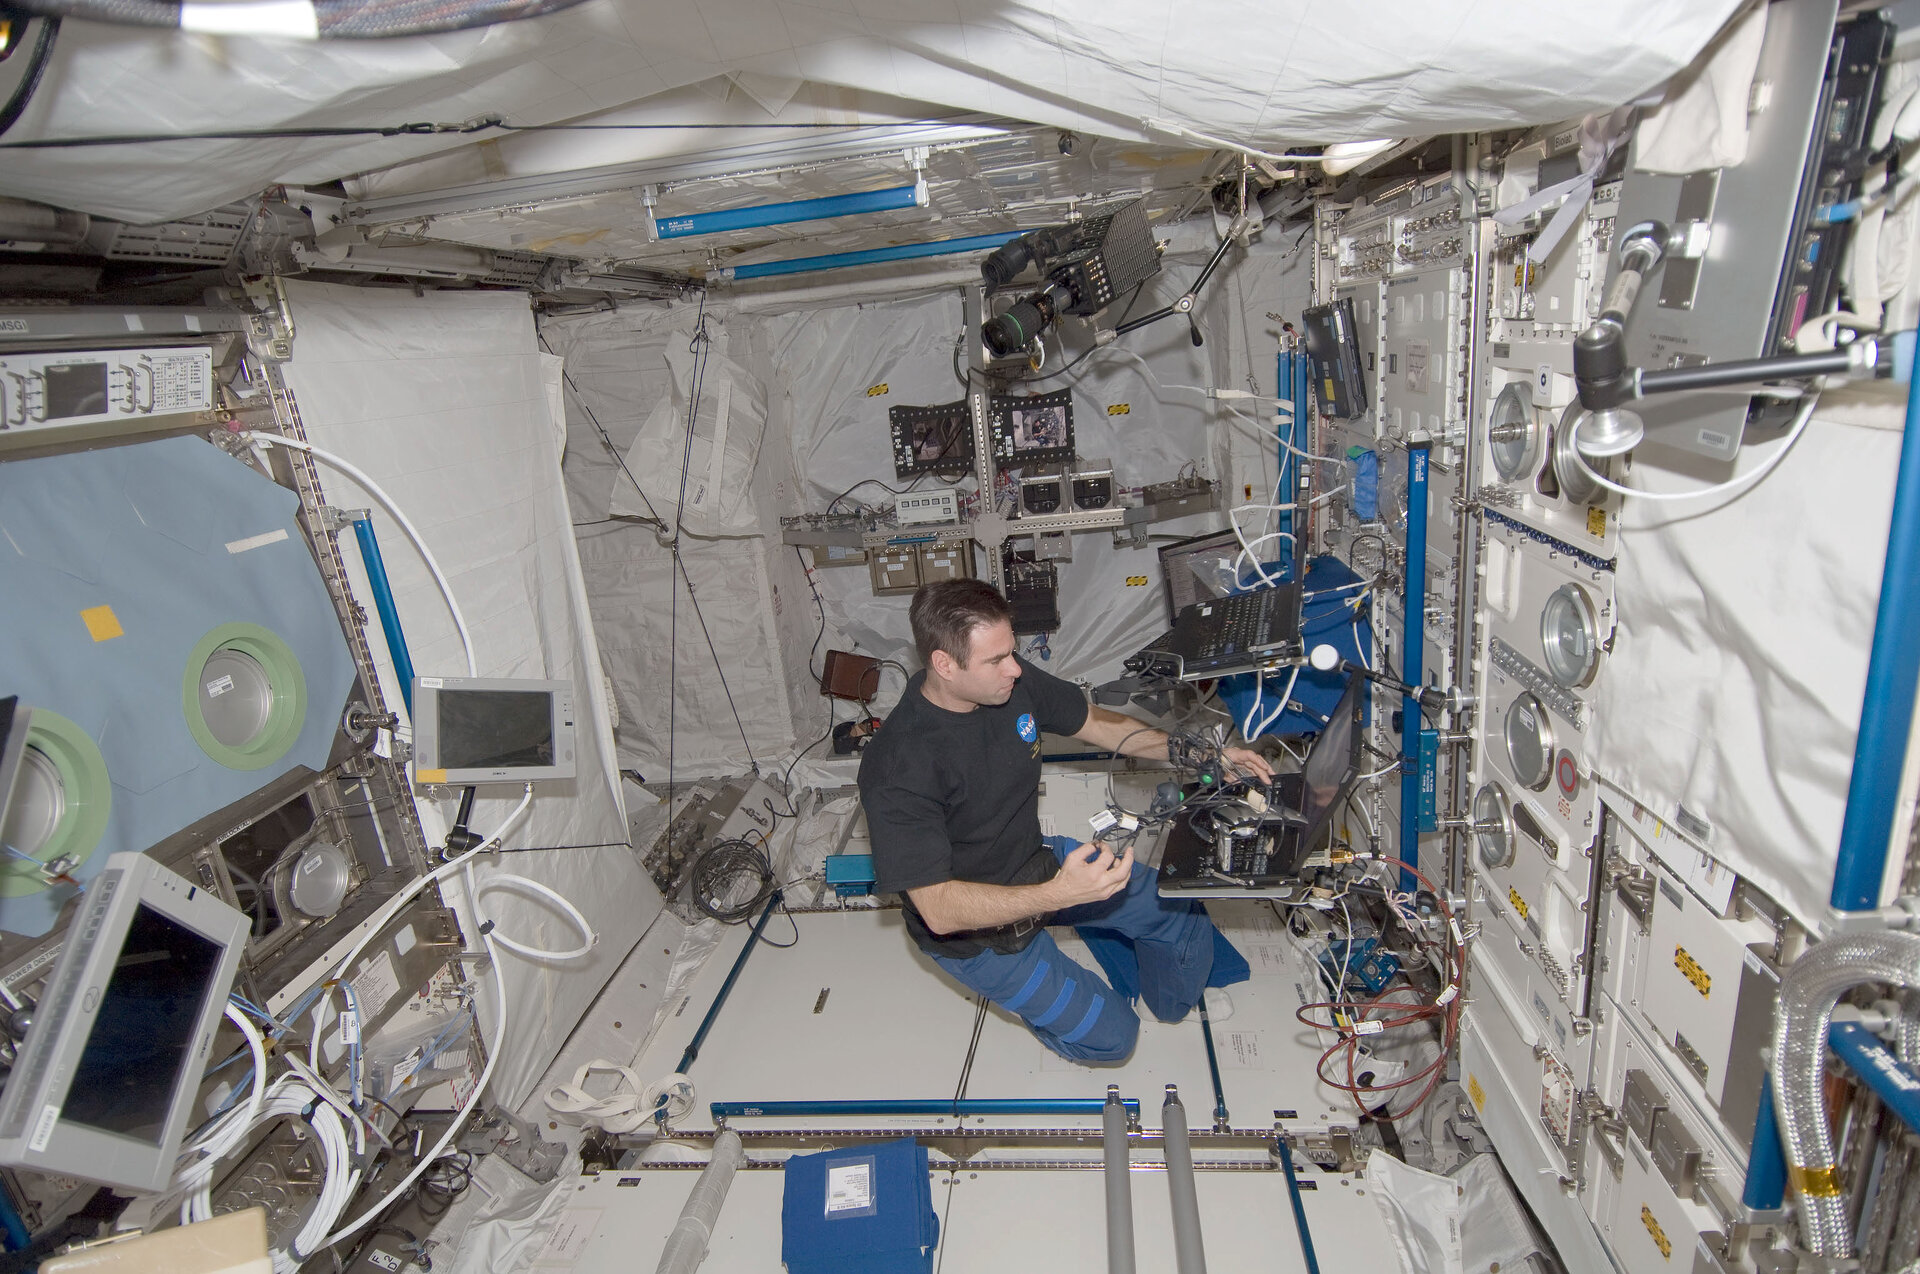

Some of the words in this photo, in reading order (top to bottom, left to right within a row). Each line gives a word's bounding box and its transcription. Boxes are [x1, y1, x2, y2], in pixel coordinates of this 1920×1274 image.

[1555, 133, 1573, 148] Biolab
[4, 963, 33, 985] POWER
[371, 1255, 380, 1264] F
